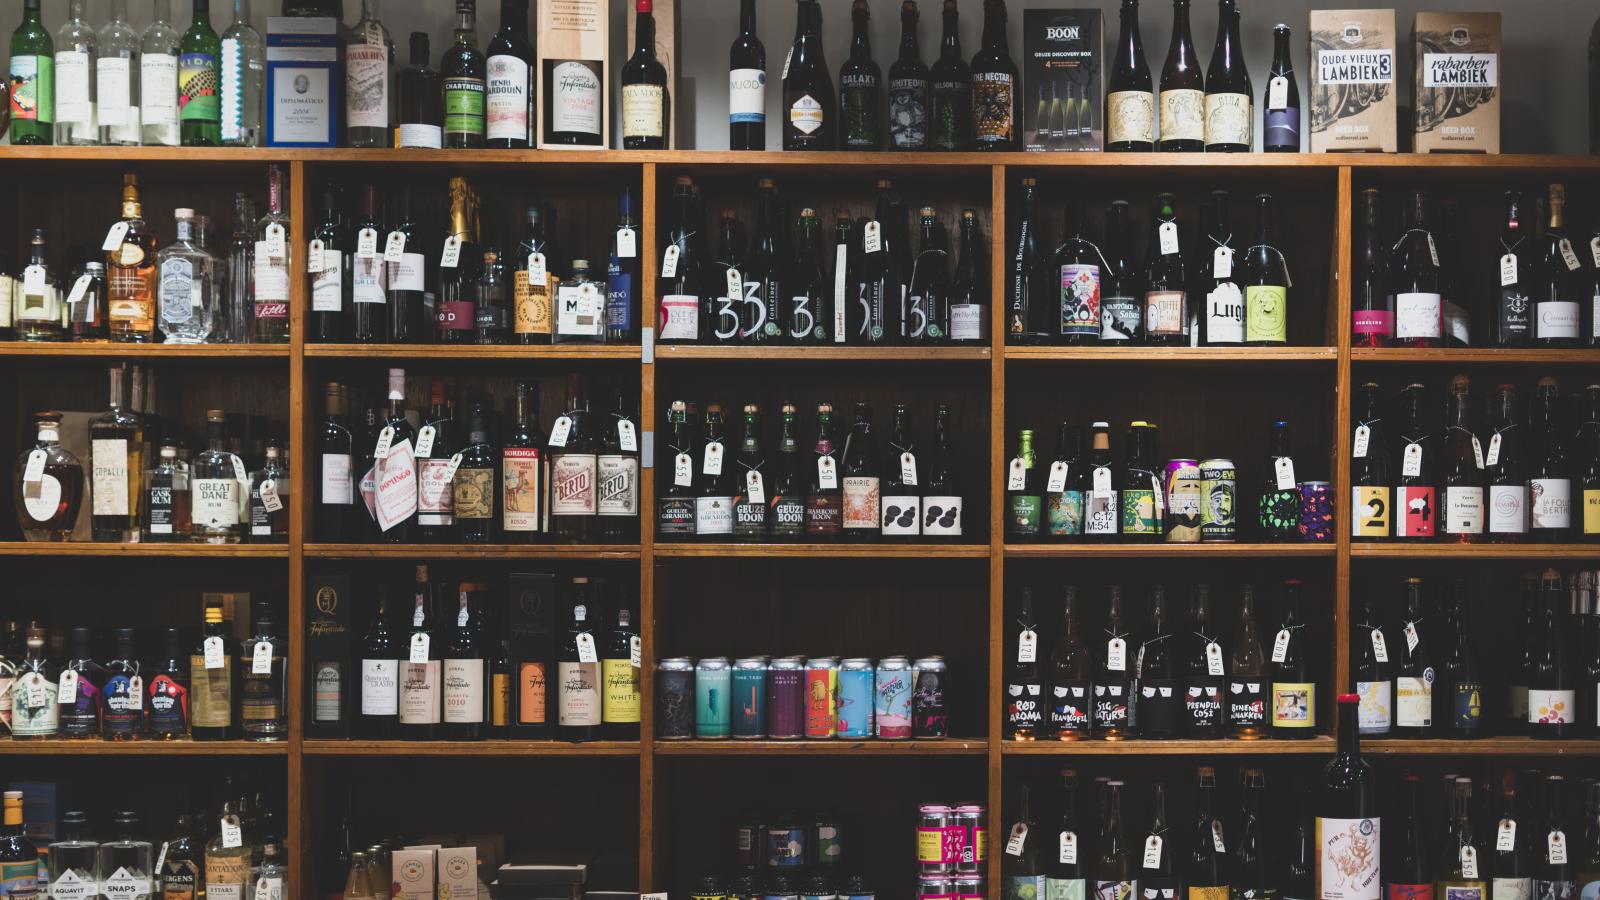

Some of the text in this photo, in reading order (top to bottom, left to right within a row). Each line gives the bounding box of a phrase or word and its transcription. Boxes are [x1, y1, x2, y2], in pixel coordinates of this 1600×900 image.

[1047, 27, 1080, 39] BOON
[180, 59, 213, 67] VIDA
[1322, 54, 1378, 65] OUDE VIEUX
[1432, 56, 1490, 71] rabarber
[1380, 56, 1391, 74] 3
[985, 72, 1010, 81] NECTAR
[1322, 66, 1379, 81] LAMBIEK
[1433, 69, 1487, 83] LAMBIEK
[843, 75, 875, 84] GALAXY
[742, 281, 767, 337] 3
[715, 297, 739, 339] 3
[791, 296, 814, 338] 3
[821, 469, 832, 480] 50
[1204, 471, 1220, 479] TWO
[379, 469, 411, 492] DOMINGO
[1012, 477, 1023, 488] 25
[199, 483, 231, 491] GREAT
[558, 473, 586, 501] BERTO
[202, 491, 229, 500] DANE
[151, 497, 171, 505] RUM
[737, 505, 765, 514] GEUZE
[776, 505, 804, 514] GEUZE
[738, 513, 764, 522] BOON
[778, 513, 803, 522] BOON
[1093, 512, 1113, 521] C:12
[1087, 522, 1109, 530] M:54
[1016, 700, 1036, 710] RØD
[1097, 701, 1111, 711] SIG
[1010, 711, 1041, 722] AROMA
[1327, 834, 1340, 846] PUR
